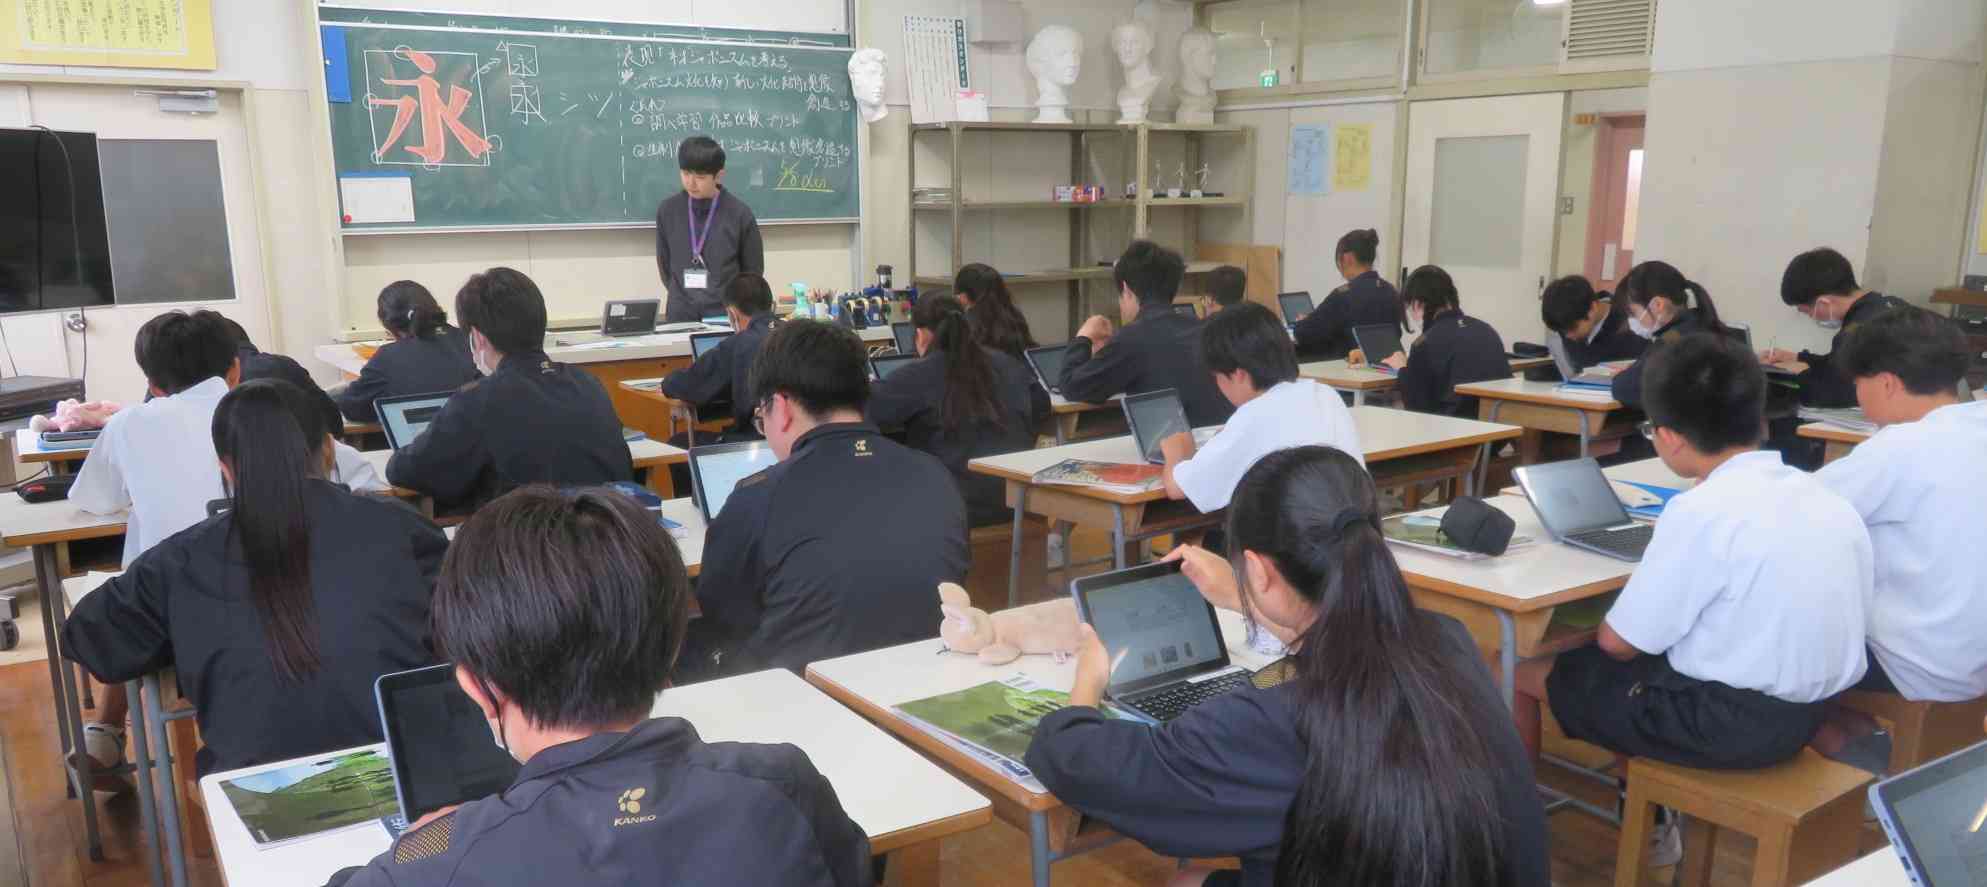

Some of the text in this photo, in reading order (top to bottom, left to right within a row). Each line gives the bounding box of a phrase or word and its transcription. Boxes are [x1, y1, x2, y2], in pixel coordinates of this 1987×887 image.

[512, 53, 537, 79] 永
[367, 48, 493, 164] 永
[510, 80, 547, 125] 永
[614, 815, 657, 826] KANKO
